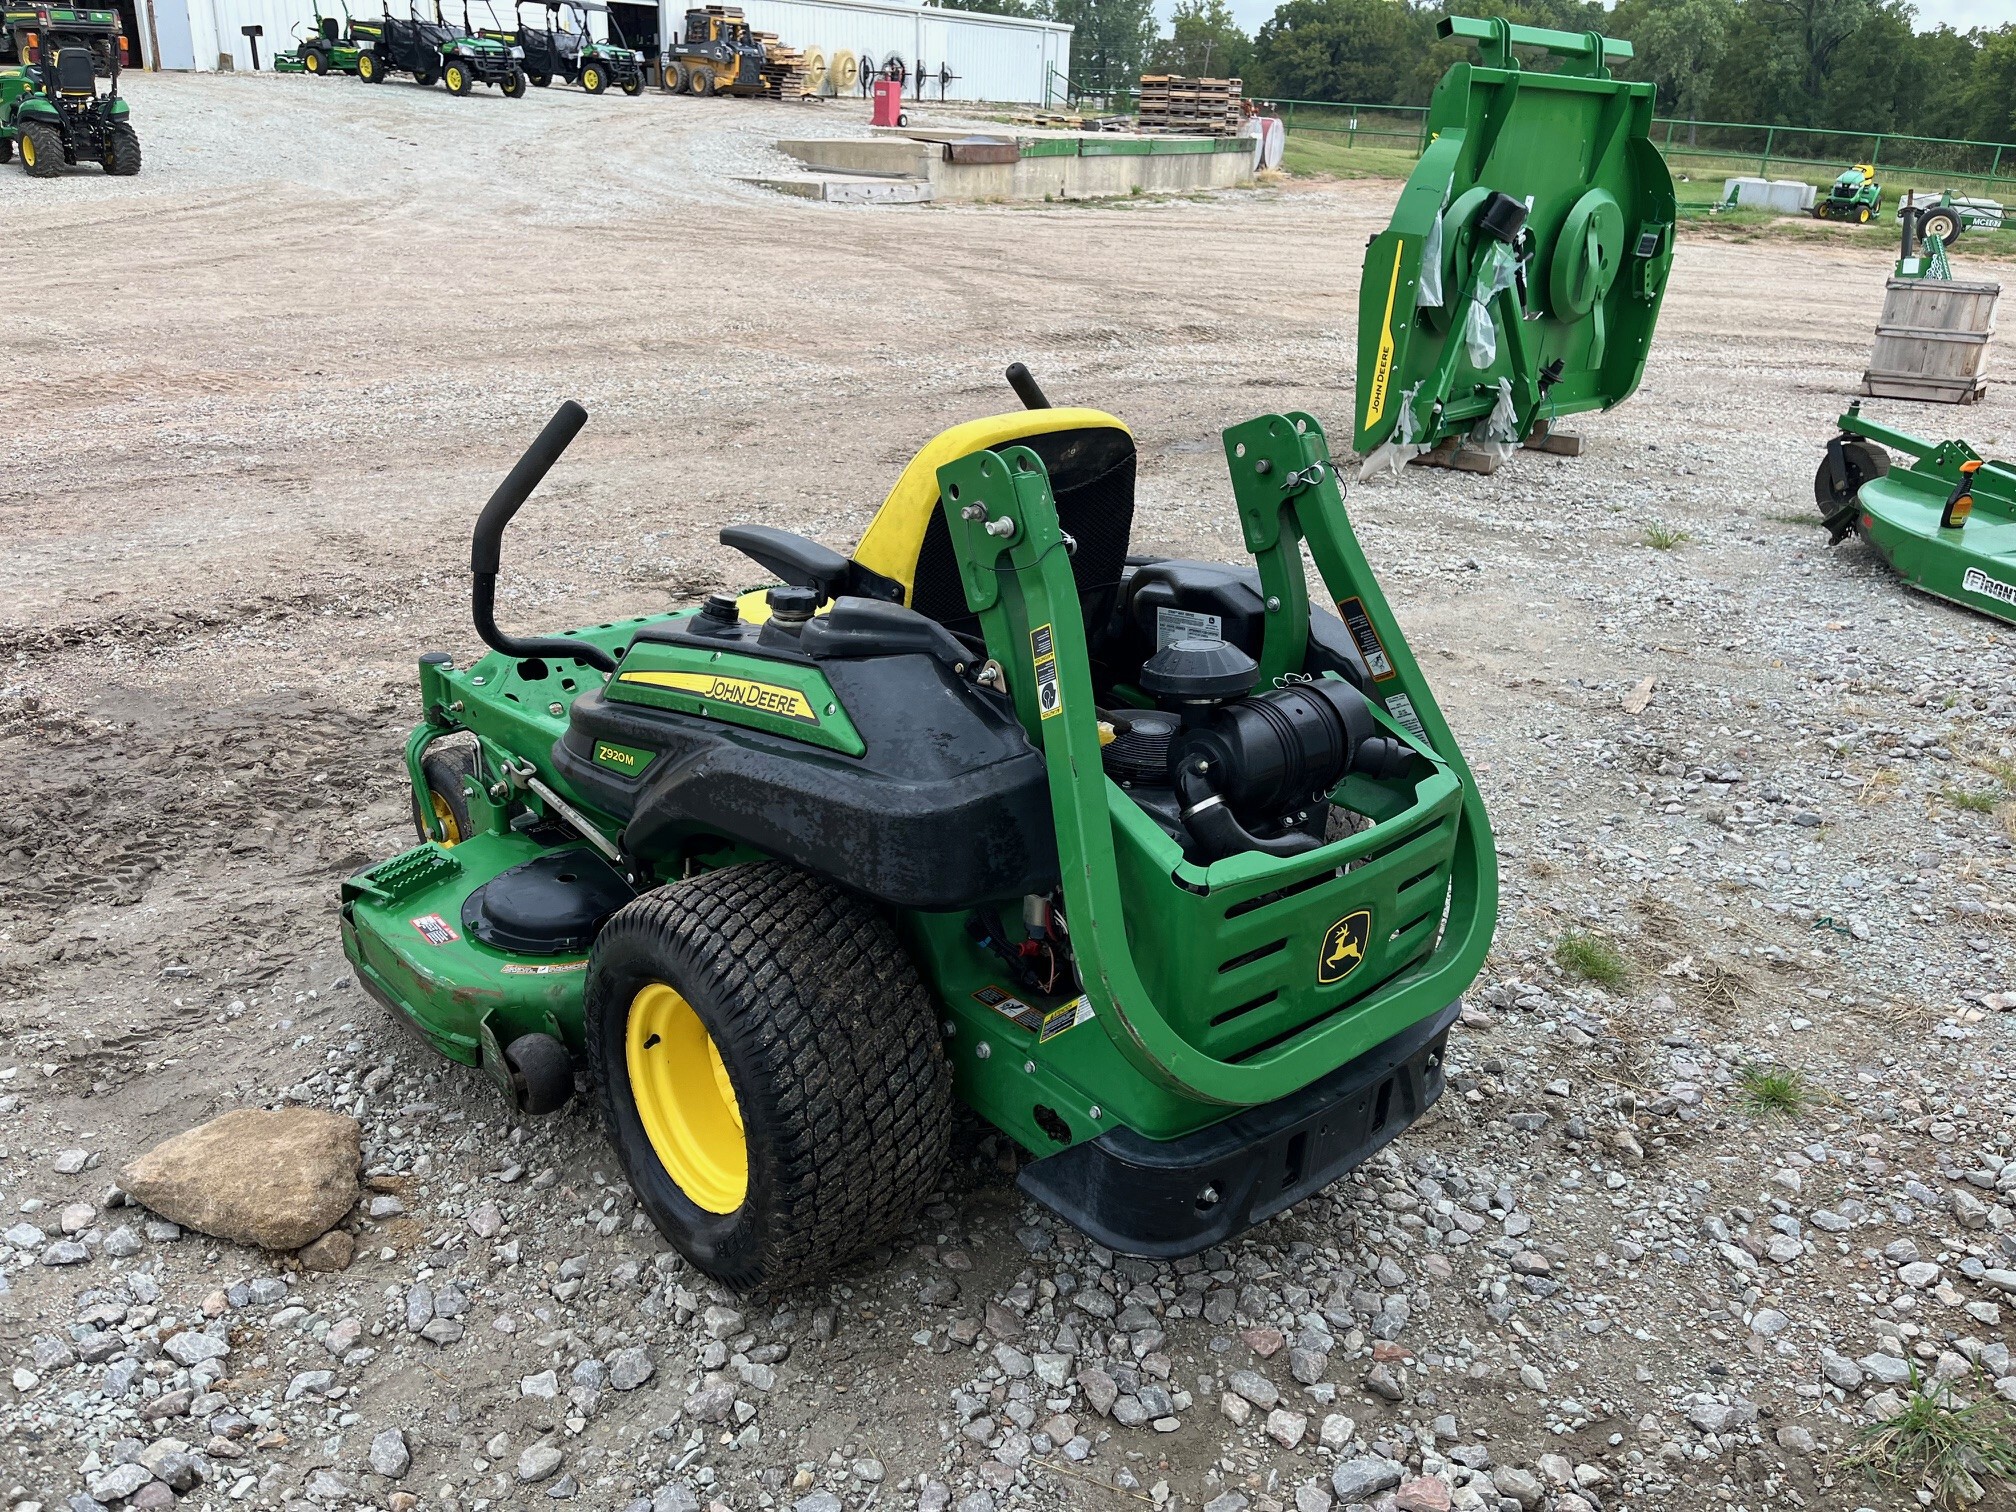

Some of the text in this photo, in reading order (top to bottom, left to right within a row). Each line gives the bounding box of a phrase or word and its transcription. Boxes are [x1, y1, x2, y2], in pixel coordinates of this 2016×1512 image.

[1372, 346, 1389, 413] JOHN DEERE
[705, 677, 799, 714] JOHN DEERE
[599, 746, 634, 766] Z920M
